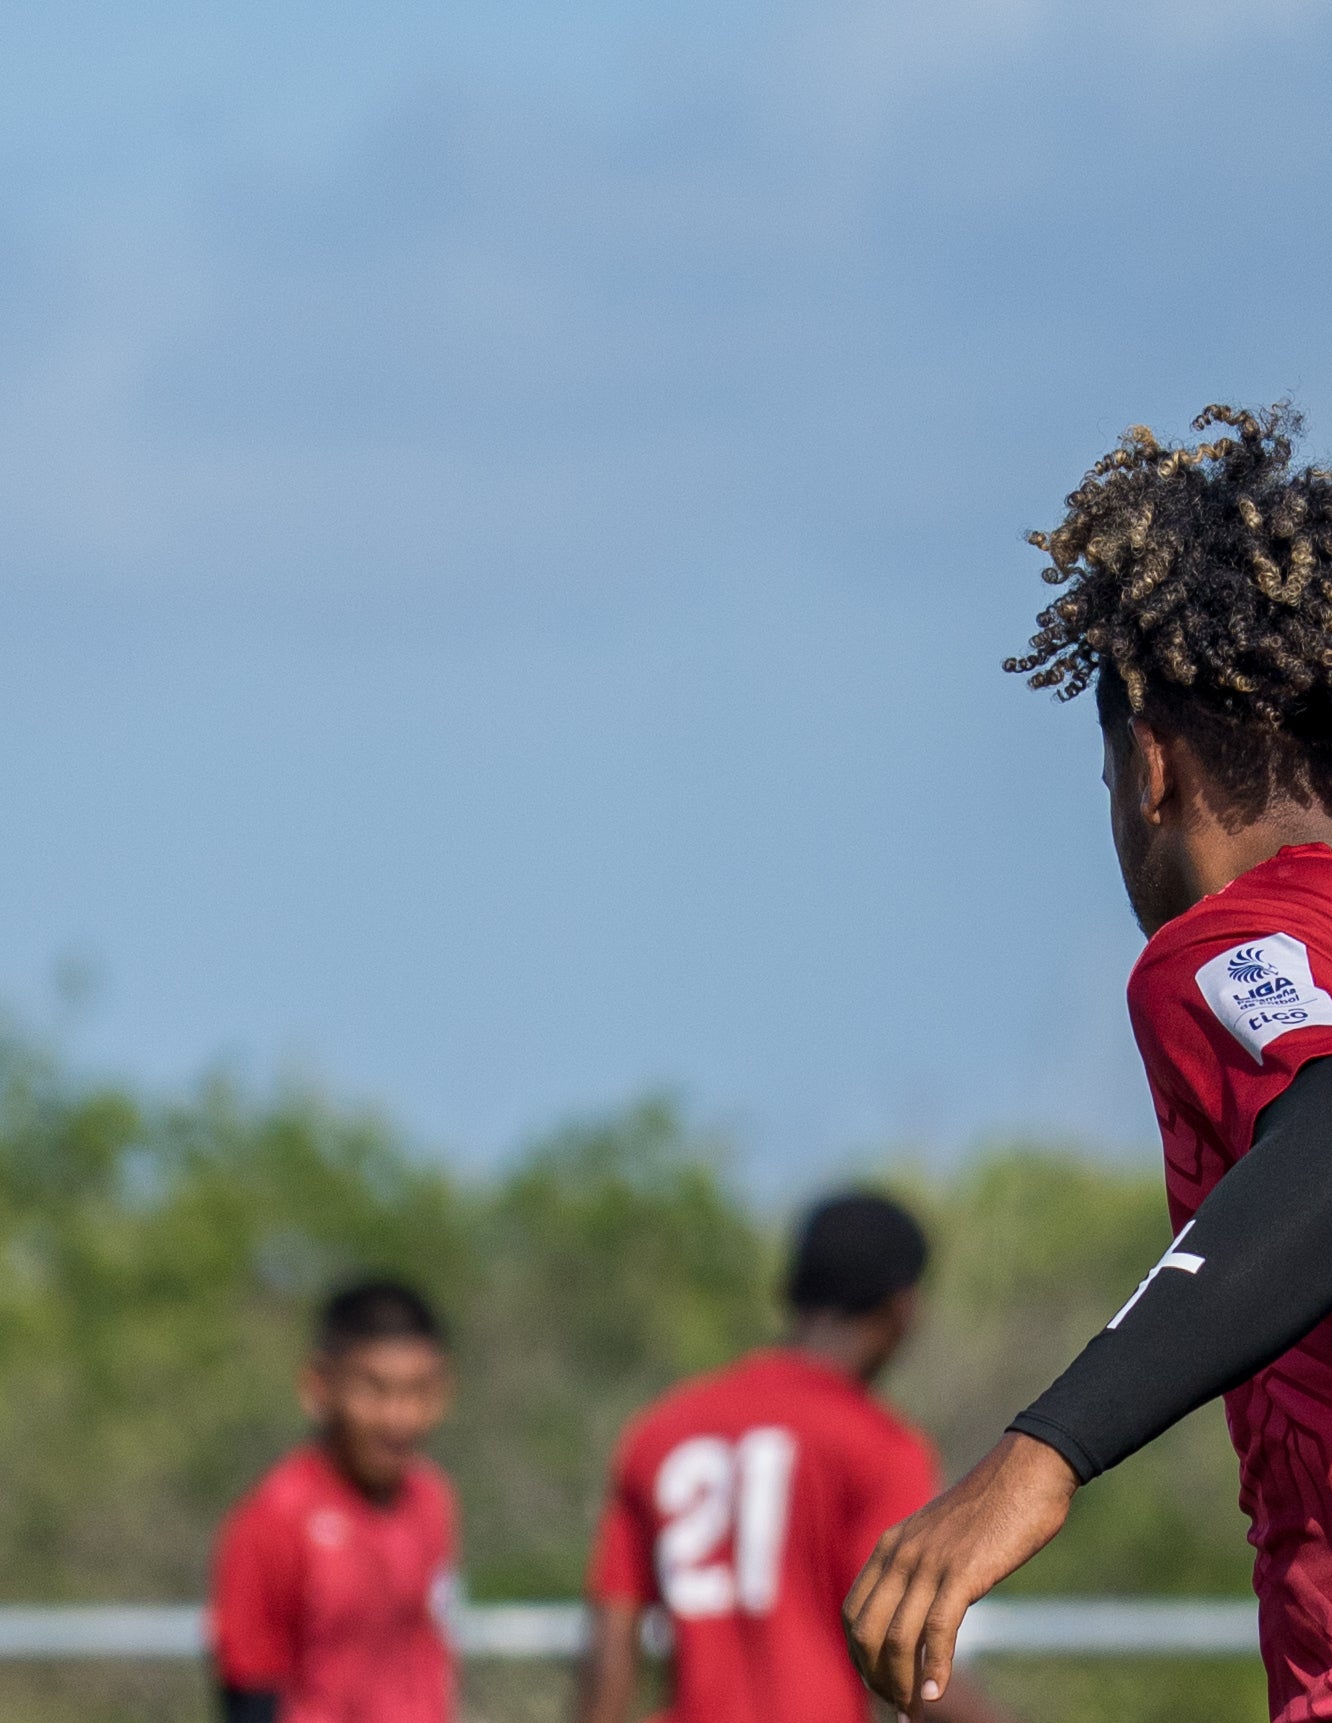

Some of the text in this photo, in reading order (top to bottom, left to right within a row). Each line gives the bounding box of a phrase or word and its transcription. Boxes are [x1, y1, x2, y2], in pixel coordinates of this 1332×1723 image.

[1233, 977, 1294, 1000] LIGA
[1249, 1009, 1308, 1030] tigo
[655, 1426, 797, 1619] 21
